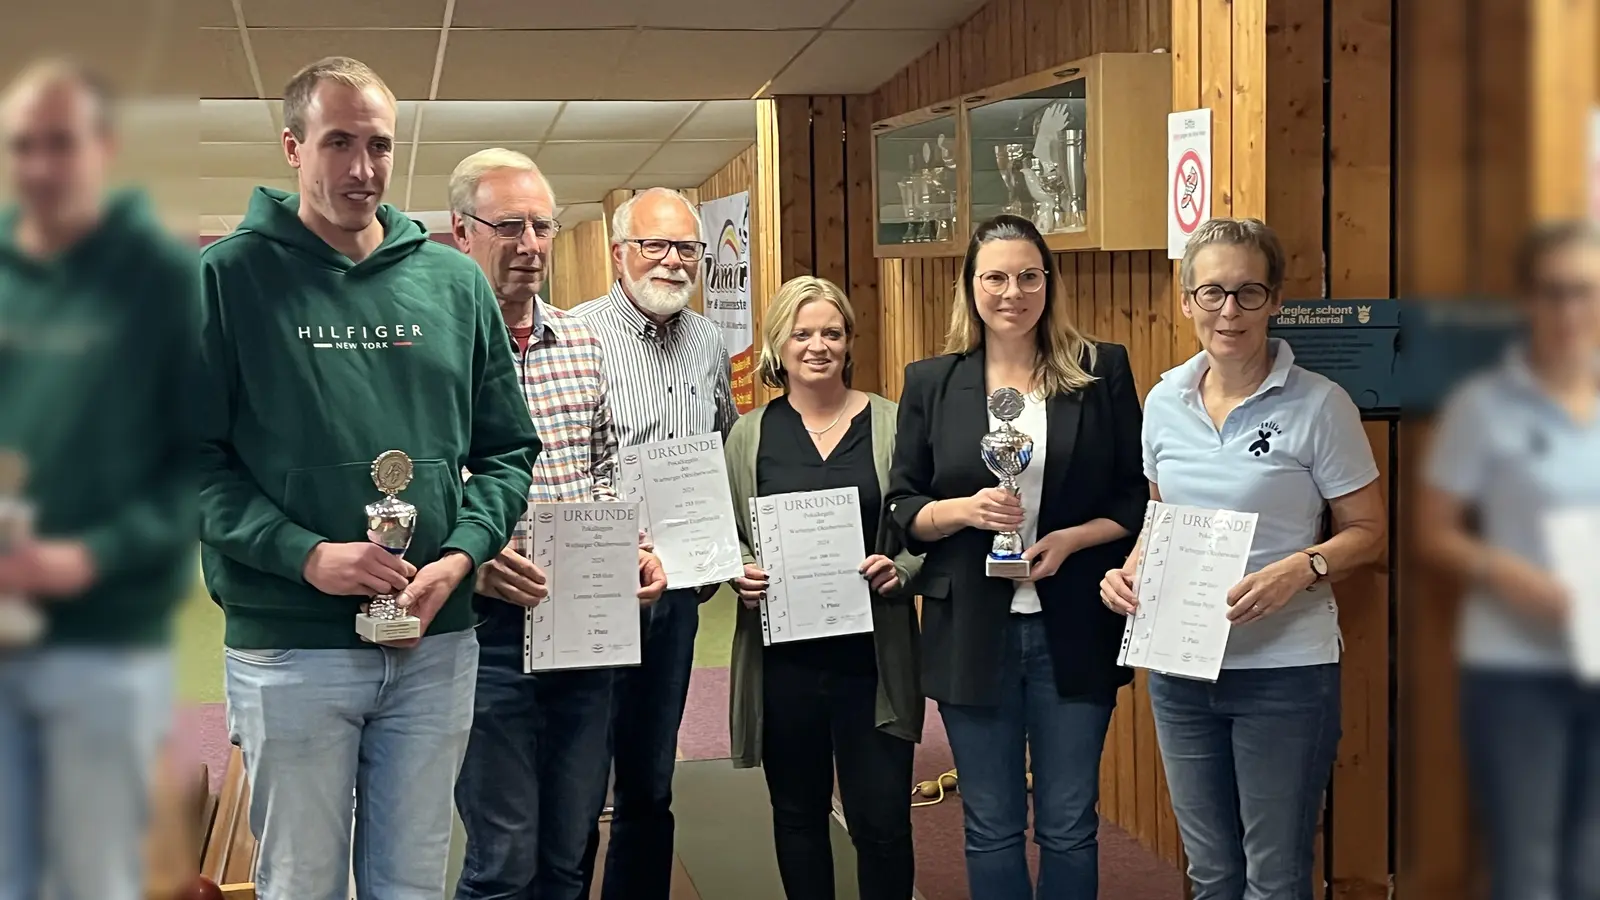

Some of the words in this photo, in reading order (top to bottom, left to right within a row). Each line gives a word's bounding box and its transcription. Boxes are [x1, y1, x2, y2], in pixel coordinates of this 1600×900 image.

[1279, 305, 1314, 317] Kegler,
[1316, 305, 1353, 315] schont
[1276, 316, 1296, 325] das
[1298, 315, 1344, 325] Material
[298, 324, 423, 339] HILFIGER
[361, 341, 389, 350] YORK
[647, 439, 718, 460] URKUNDE
[784, 494, 855, 511] URKUNDE
[563, 508, 635, 522] URKUNDE
